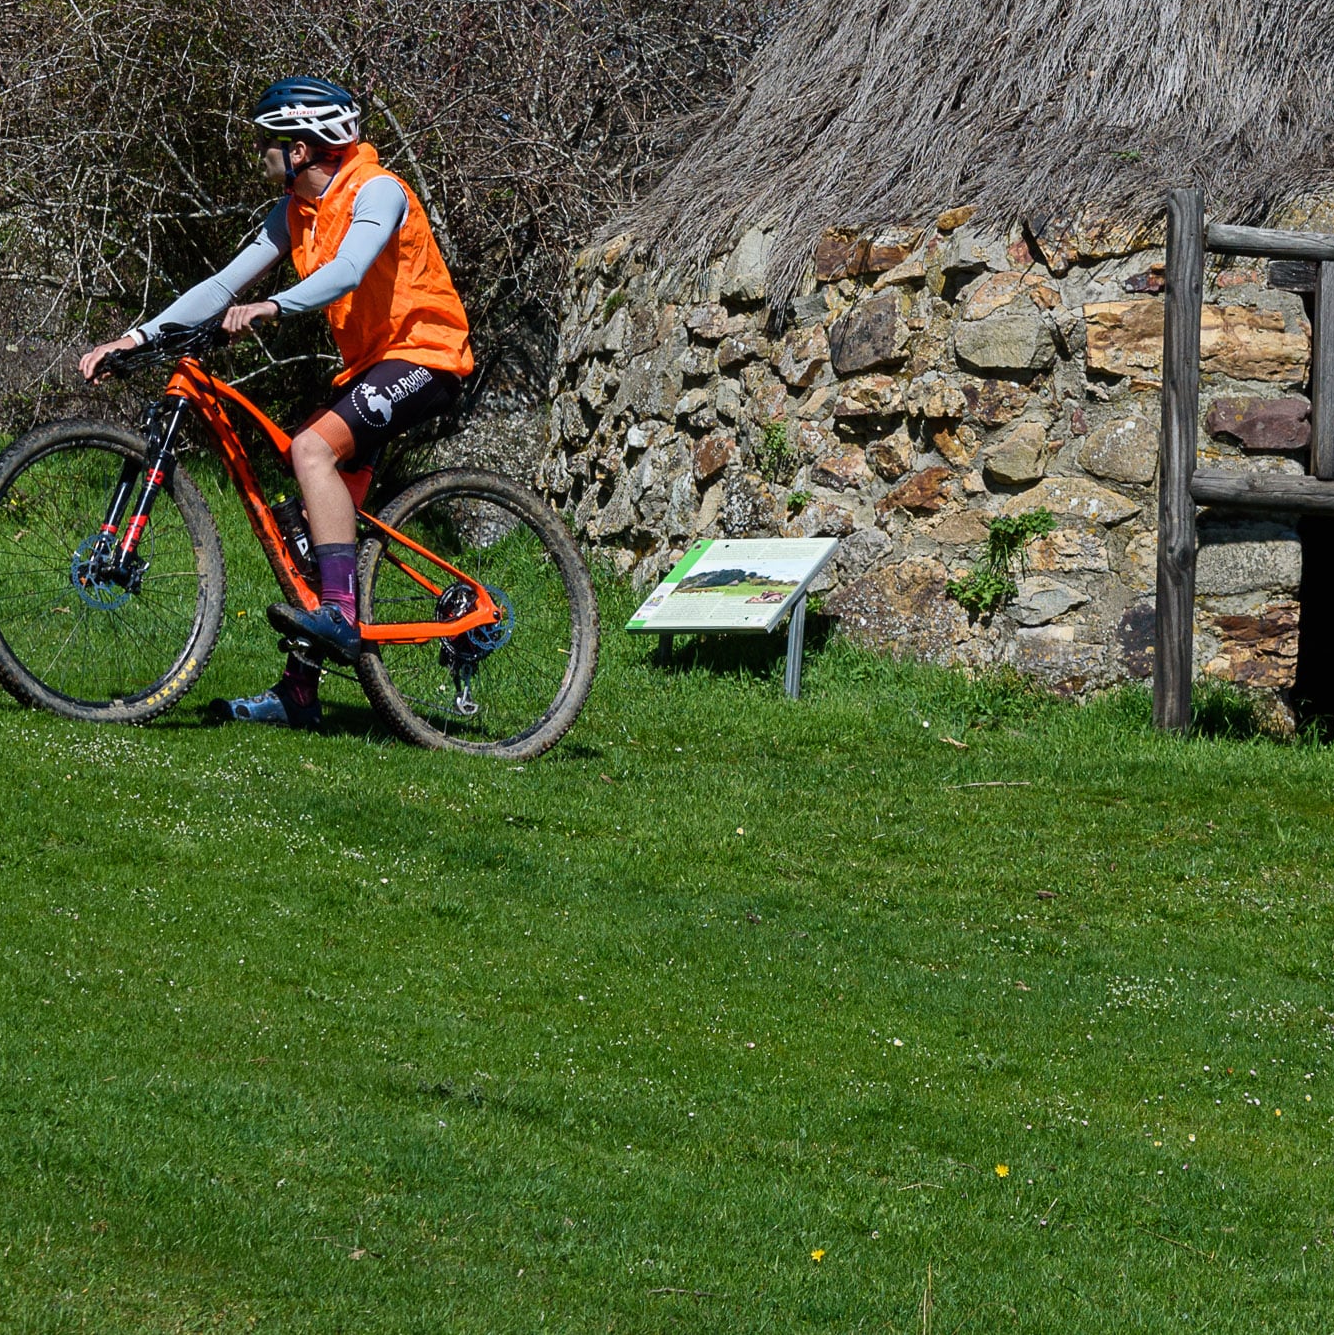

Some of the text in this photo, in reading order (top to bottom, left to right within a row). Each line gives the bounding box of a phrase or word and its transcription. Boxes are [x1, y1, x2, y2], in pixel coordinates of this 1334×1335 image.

[385, 366, 430, 398] La Ruina
[146, 657, 197, 706] MAXXIS
